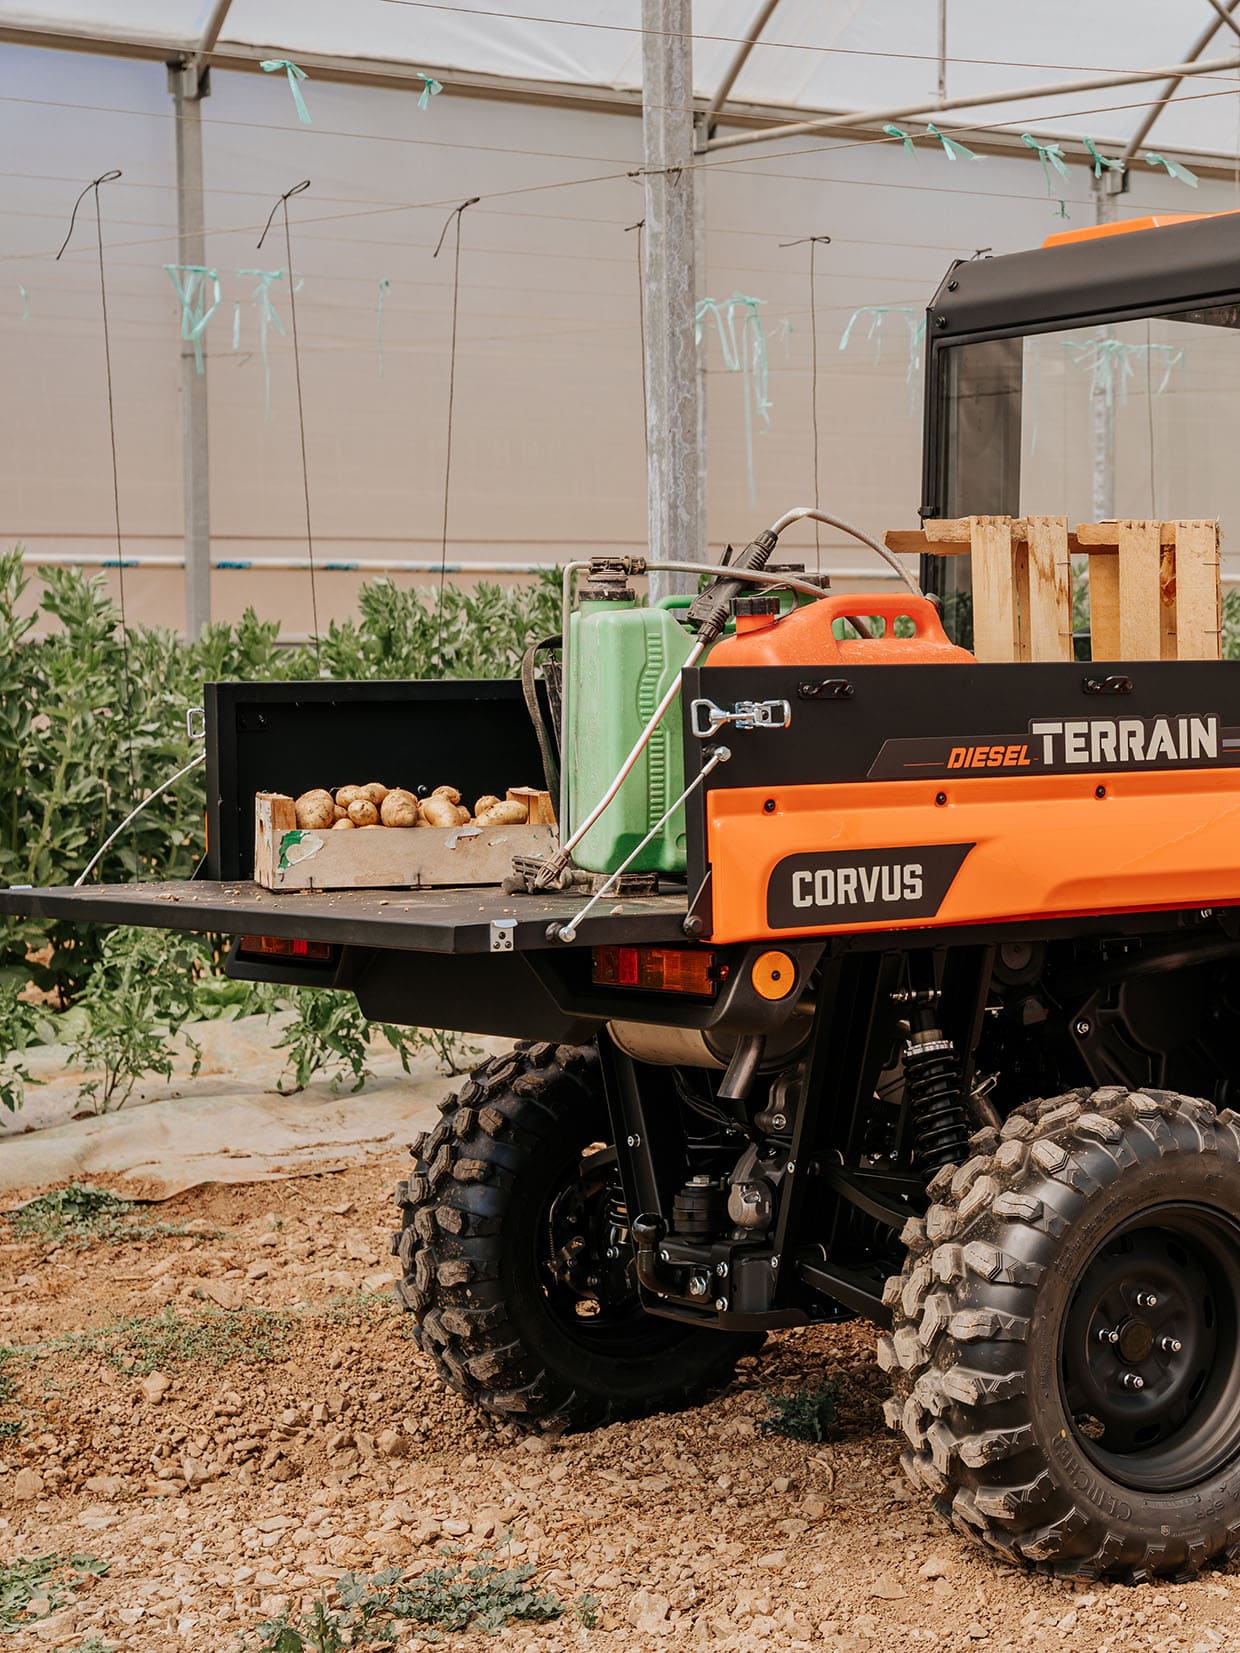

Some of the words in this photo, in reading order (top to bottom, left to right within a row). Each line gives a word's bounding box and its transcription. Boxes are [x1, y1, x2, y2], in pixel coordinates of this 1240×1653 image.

[947, 744, 1031, 769] DIESEL
[1032, 717, 1218, 765] TERRAIN
[792, 863, 923, 908] CORVUS
